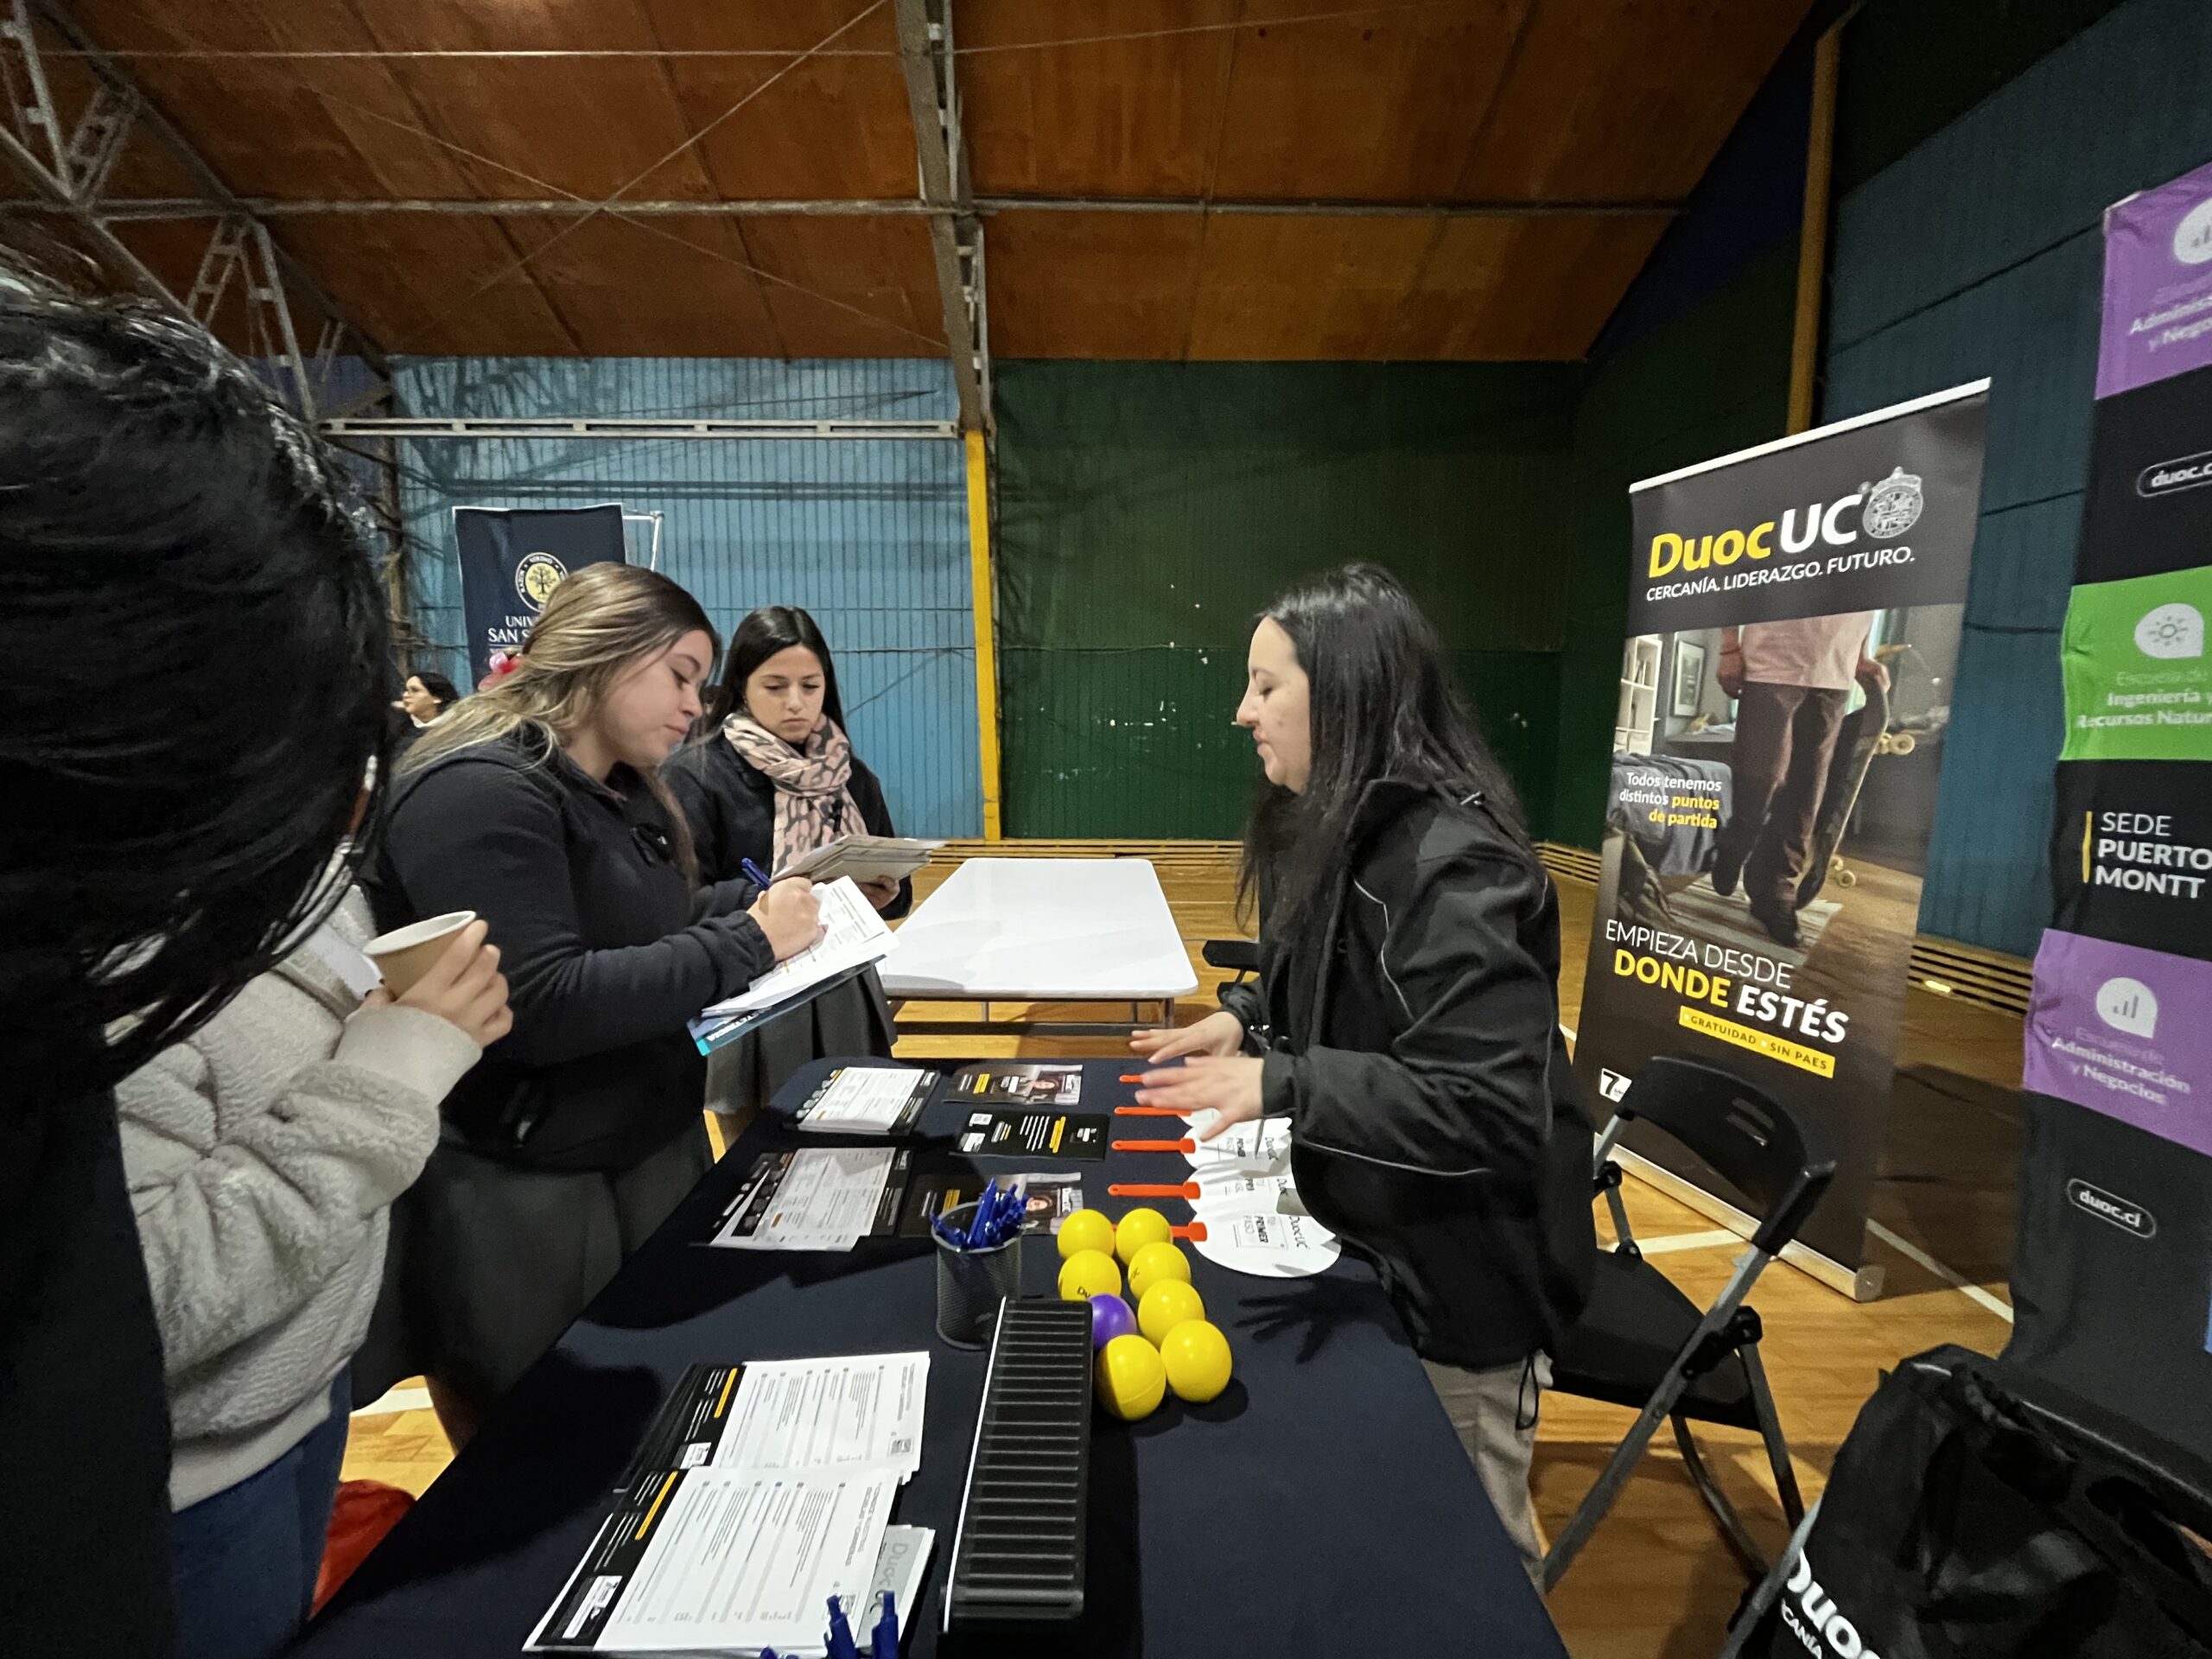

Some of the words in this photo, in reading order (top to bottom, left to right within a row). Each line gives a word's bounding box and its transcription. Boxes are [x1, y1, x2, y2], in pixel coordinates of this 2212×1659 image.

[1646, 575, 1720, 601] CERCANÍA.
[1723, 562, 1823, 591] LIDERAZGO.
[1827, 546, 1915, 575] FUTURO.
[488, 627, 518, 643] SAN
[2107, 690, 2202, 709] Ingeniería
[2077, 712, 2153, 729] Recursos
[1626, 772, 1661, 787] Todos
[1663, 776, 1722, 792] tenemos
[1619, 789, 1669, 806] distintos
[1672, 796, 1719, 812] puntos
[1649, 809, 1666, 823] de
[1668, 811, 1718, 830] partida
[2100, 811, 2173, 837] SEDE
[2097, 837, 2212, 871] PUERTO
[2094, 864, 2206, 899] MONTT
[1605, 918, 1698, 964] EMPIEZA
[1705, 939, 1795, 989] DESDE
[1614, 949, 1731, 1008] DONDE
[1736, 984, 1849, 1044] ESTÉS
[1691, 1015, 1758, 1046] GRATUIDAD
[1769, 1041, 1792, 1058] SIN
[1795, 1050, 1827, 1071] PAES
[2051, 1035, 2191, 1095] Administración
[2082, 1064, 2167, 1105] Negocios
[2079, 1188, 2142, 1229] duoc.cl
